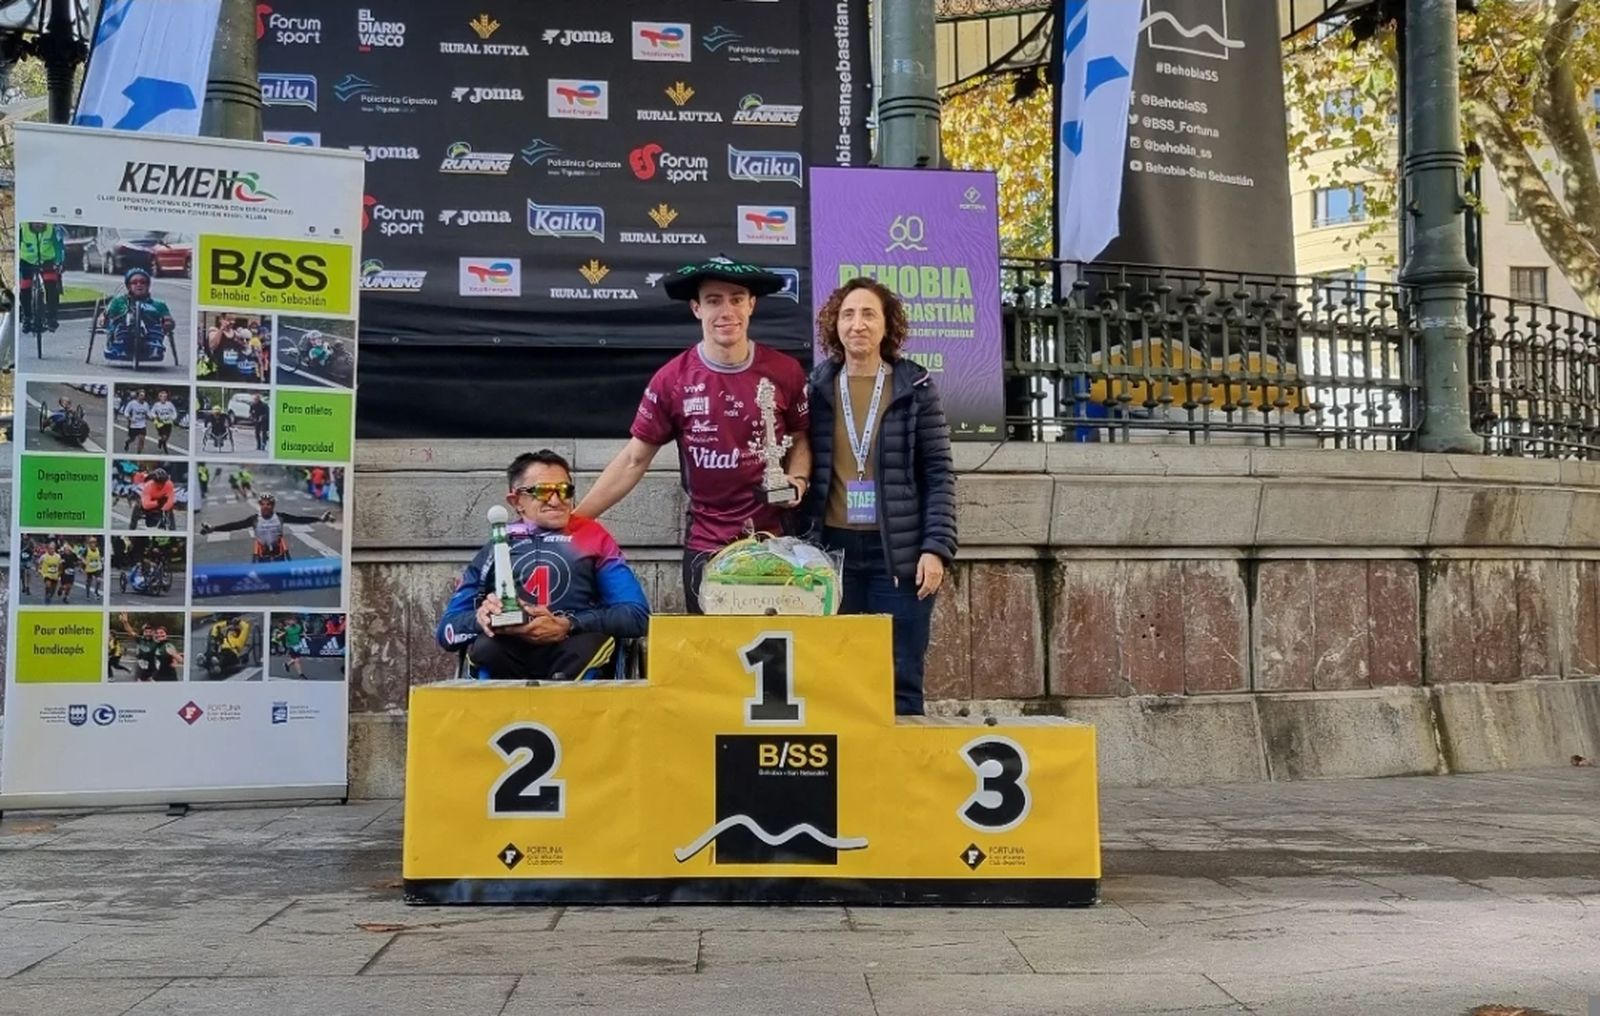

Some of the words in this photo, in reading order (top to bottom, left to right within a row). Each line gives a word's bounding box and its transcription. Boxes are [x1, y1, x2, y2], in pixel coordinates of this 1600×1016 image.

[358, 9, 375, 22] EL
[358, 22, 406, 35] DIARIO
[276, 31, 321, 45] sport
[359, 34, 404, 47] VASCO
[440, 42, 482, 55] RURAL
[483, 44, 529, 56] KUTXA
[1156, 62, 1219, 82] #BehobiaSS
[261, 79, 309, 99] aiku
[1141, 94, 1208, 113] @BehobiaSS
[637, 109, 677, 121] RURAL
[678, 111, 723, 123] KUTXA
[733, 110, 800, 122] RUNNING
[1142, 117, 1220, 138] @BSS_Fortuna
[440, 158, 512, 171] RUNNING
[735, 155, 795, 176] Kaiku
[118, 161, 239, 200] KEMEN
[667, 168, 708, 184] sport
[535, 210, 596, 231] Kaiku
[380, 221, 424, 237] sport
[889, 215, 924, 242] 60
[620, 232, 661, 244] RURAL
[662, 233, 707, 245] KUTXA
[211, 248, 328, 292] B/SS
[211, 288, 250, 302] Behobia
[260, 291, 278, 304] San
[550, 288, 592, 299] RURAL
[593, 289, 638, 299] KUTXA
[903, 300, 975, 322] BASTIÁN
[282, 402, 302, 416] Para
[304, 404, 333, 417] atletas
[281, 423, 296, 433] con
[280, 440, 334, 454] discapacidad
[688, 446, 740, 469] Vital
[37, 469, 99, 484] Desgaitasuna
[37, 489, 63, 501] duten
[36, 508, 86, 521] atletentzat
[34, 624, 57, 636] Pour
[58, 624, 95, 636] athletes
[33, 643, 85, 656] handicapés
[738, 632, 806, 727] 1
[759, 742, 828, 768] B/SS
[487, 722, 566, 819] 2
[956, 736, 1032, 834] 3
